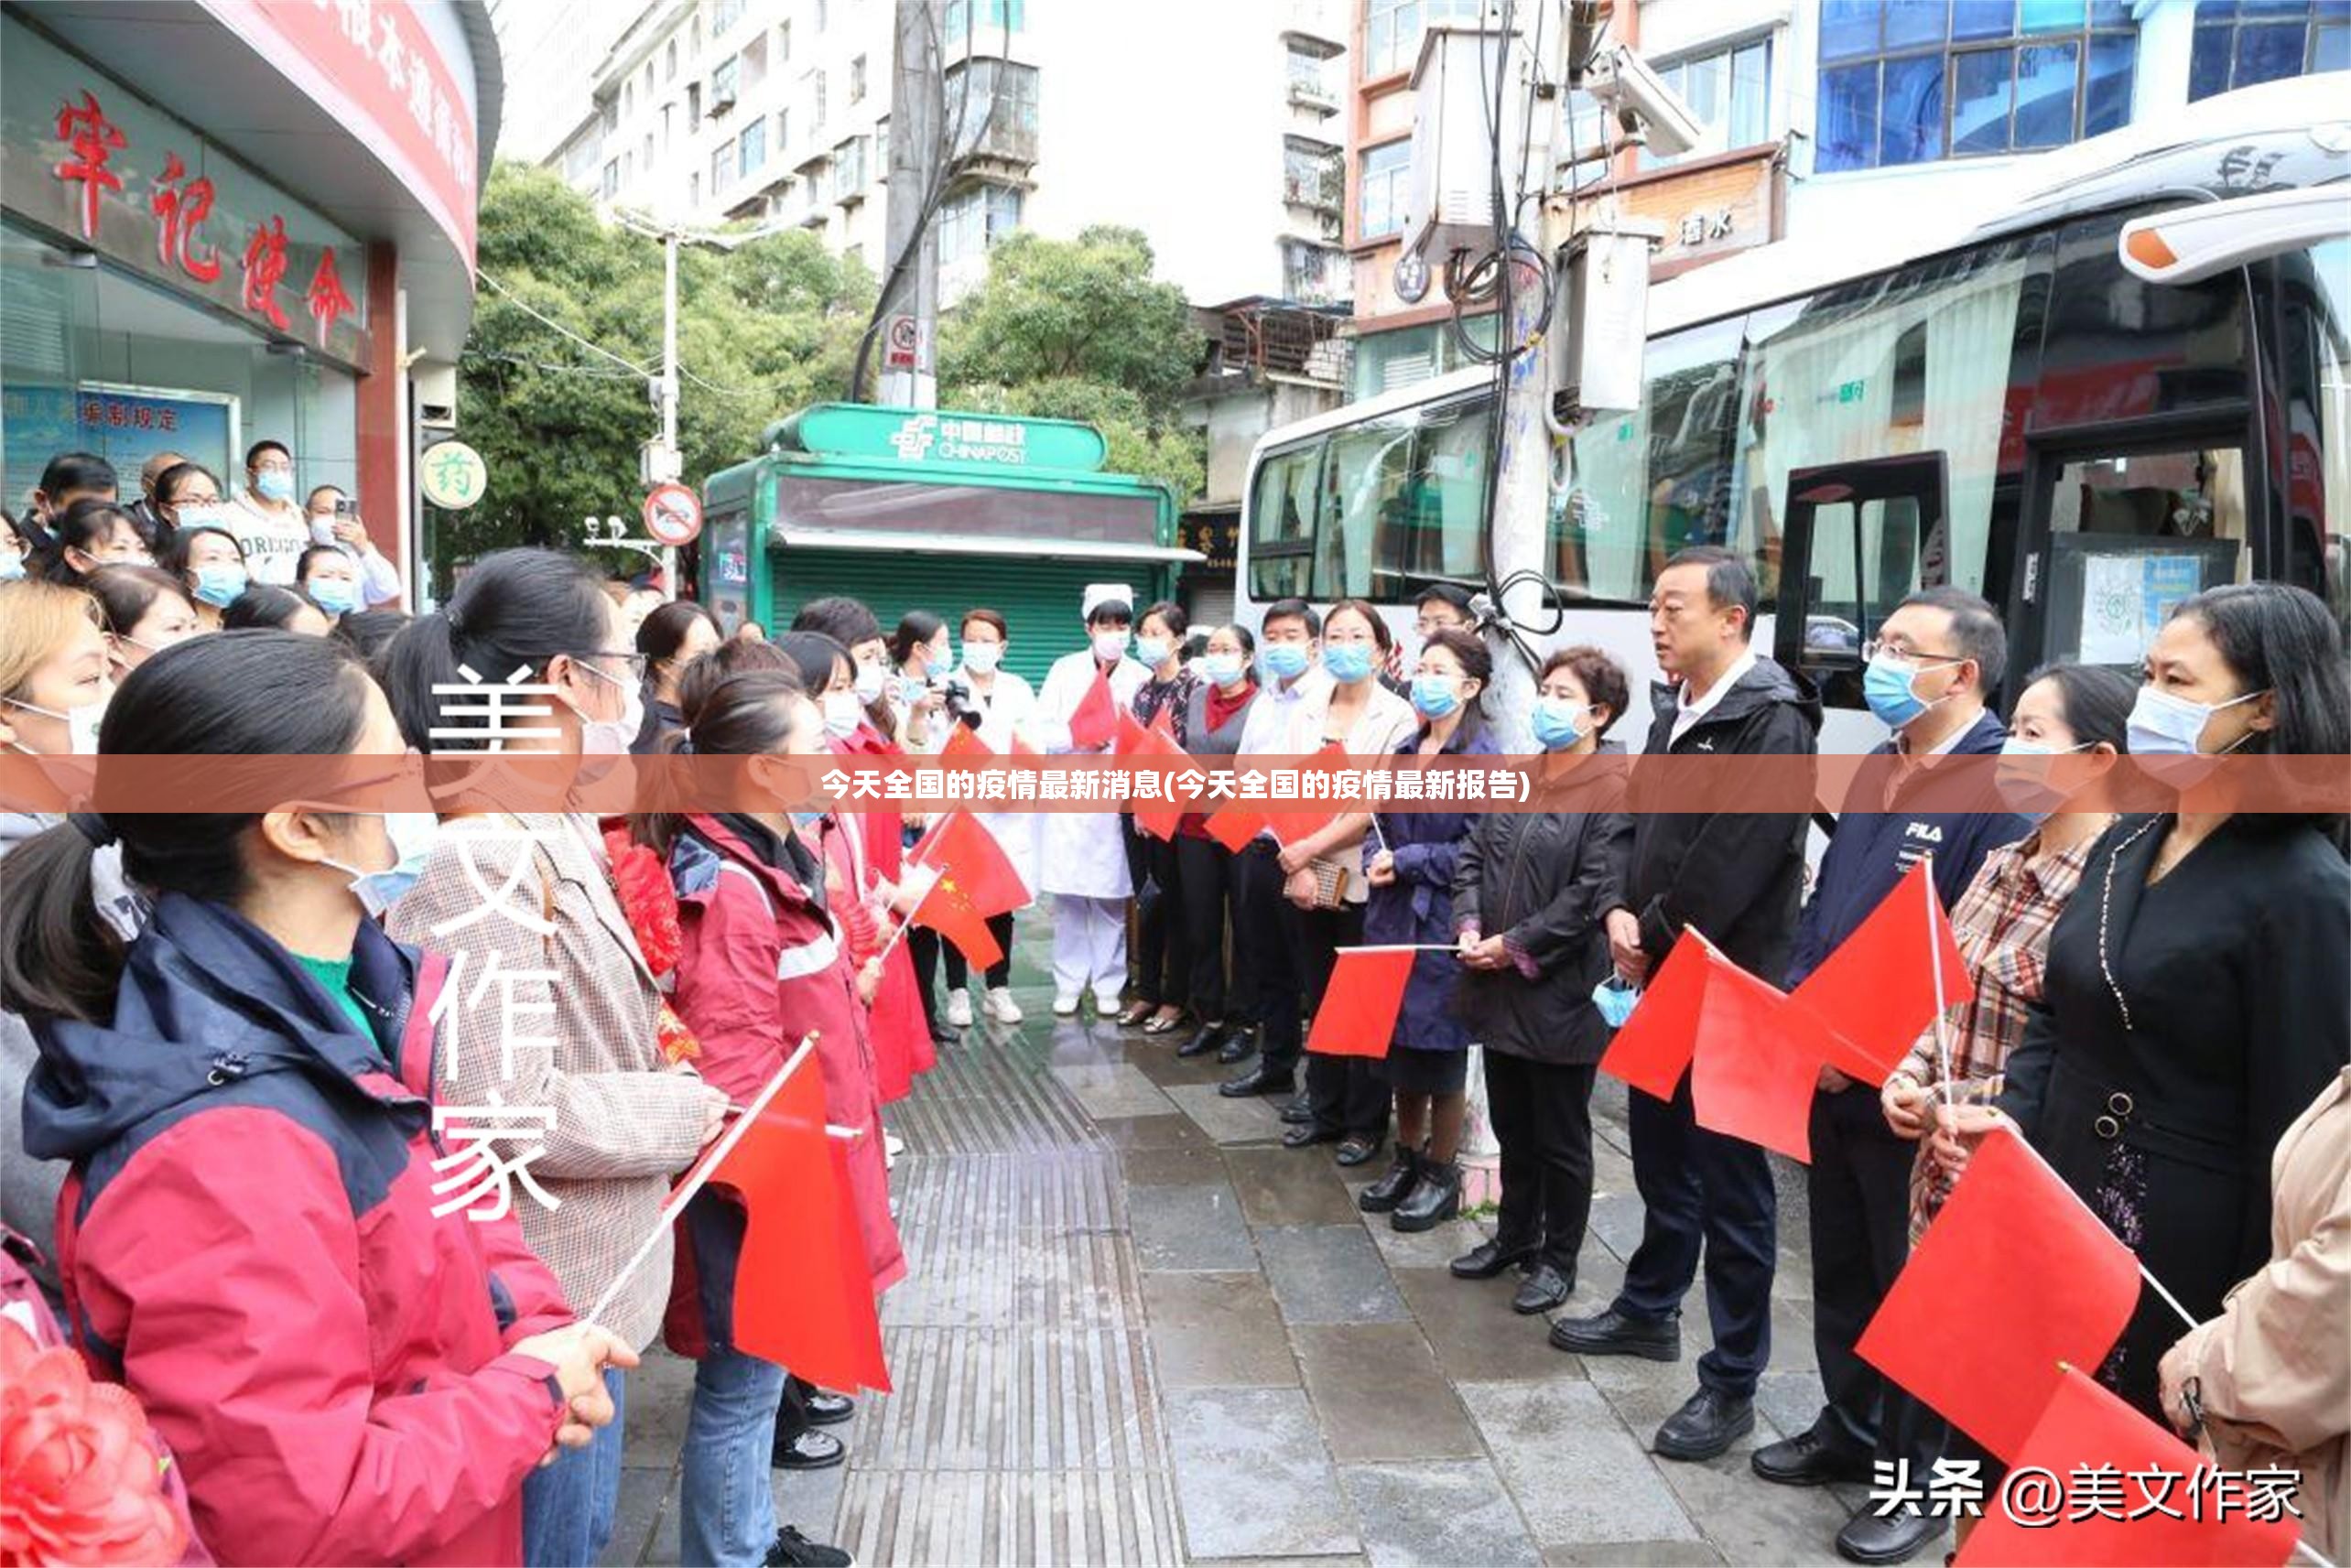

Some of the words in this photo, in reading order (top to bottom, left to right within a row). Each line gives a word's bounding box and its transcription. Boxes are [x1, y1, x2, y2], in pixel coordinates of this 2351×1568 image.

[53, 90, 355, 348] 牢记使命
[430, 449, 476, 497] 药
[1905, 822, 1942, 842] FILA
